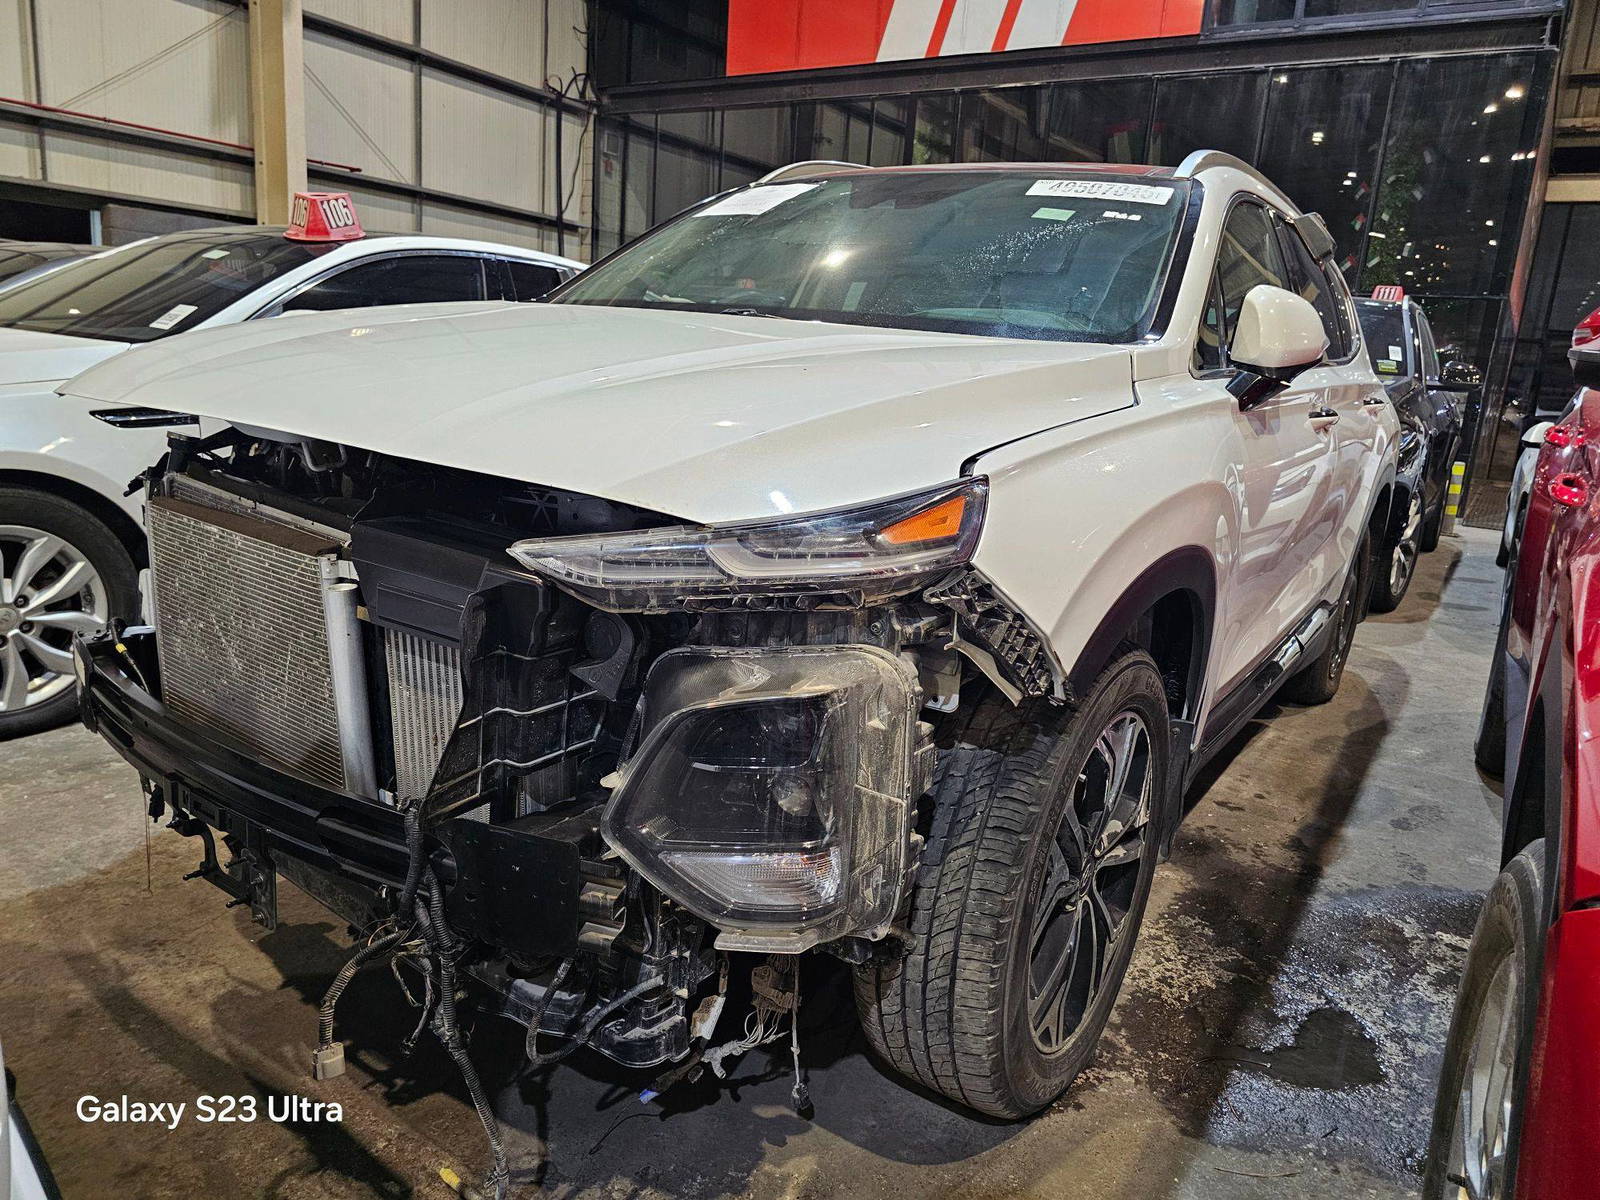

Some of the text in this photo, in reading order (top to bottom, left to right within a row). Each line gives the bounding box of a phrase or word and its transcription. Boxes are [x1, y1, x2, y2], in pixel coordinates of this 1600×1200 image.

[293, 197, 308, 227] 106
[322, 197, 354, 229] 106
[1378, 287, 1396, 300] 111
